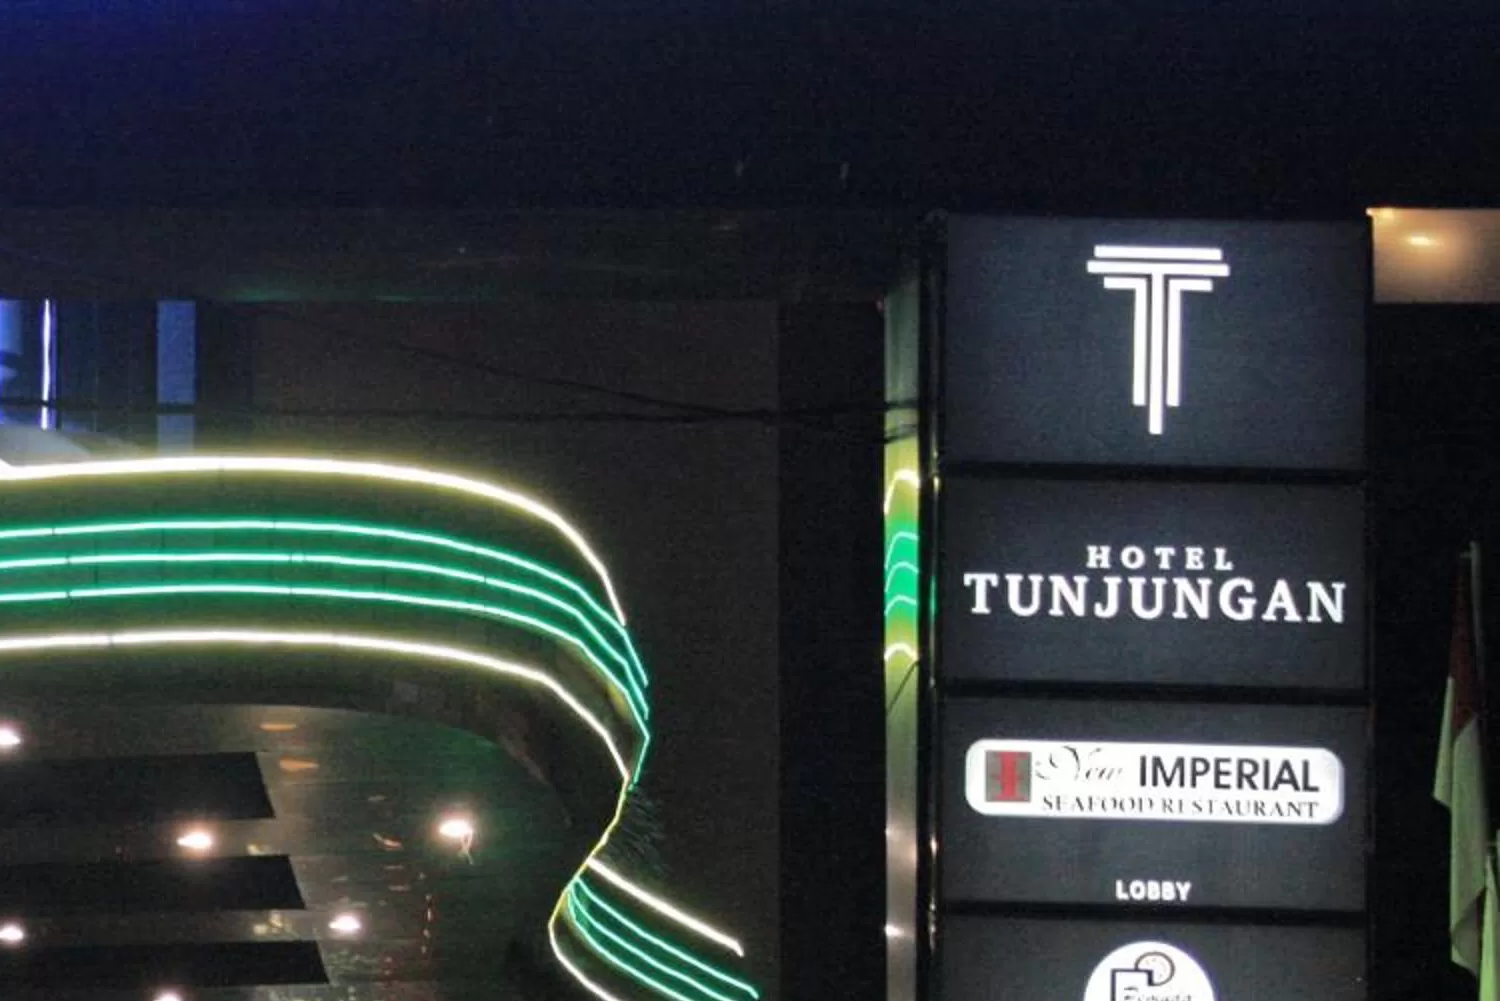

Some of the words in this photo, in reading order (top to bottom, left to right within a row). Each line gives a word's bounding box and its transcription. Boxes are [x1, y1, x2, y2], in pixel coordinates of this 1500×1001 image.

[1086, 545, 1233, 571] HOTEL
[963, 573, 1346, 623] TUNJUNGAN
[1139, 755, 1320, 793] IMPERIAL
[1042, 795, 1155, 813] SEAFOOD
[1161, 797, 1320, 818] RESTAURANT
[1115, 879, 1192, 901] LOBBY
